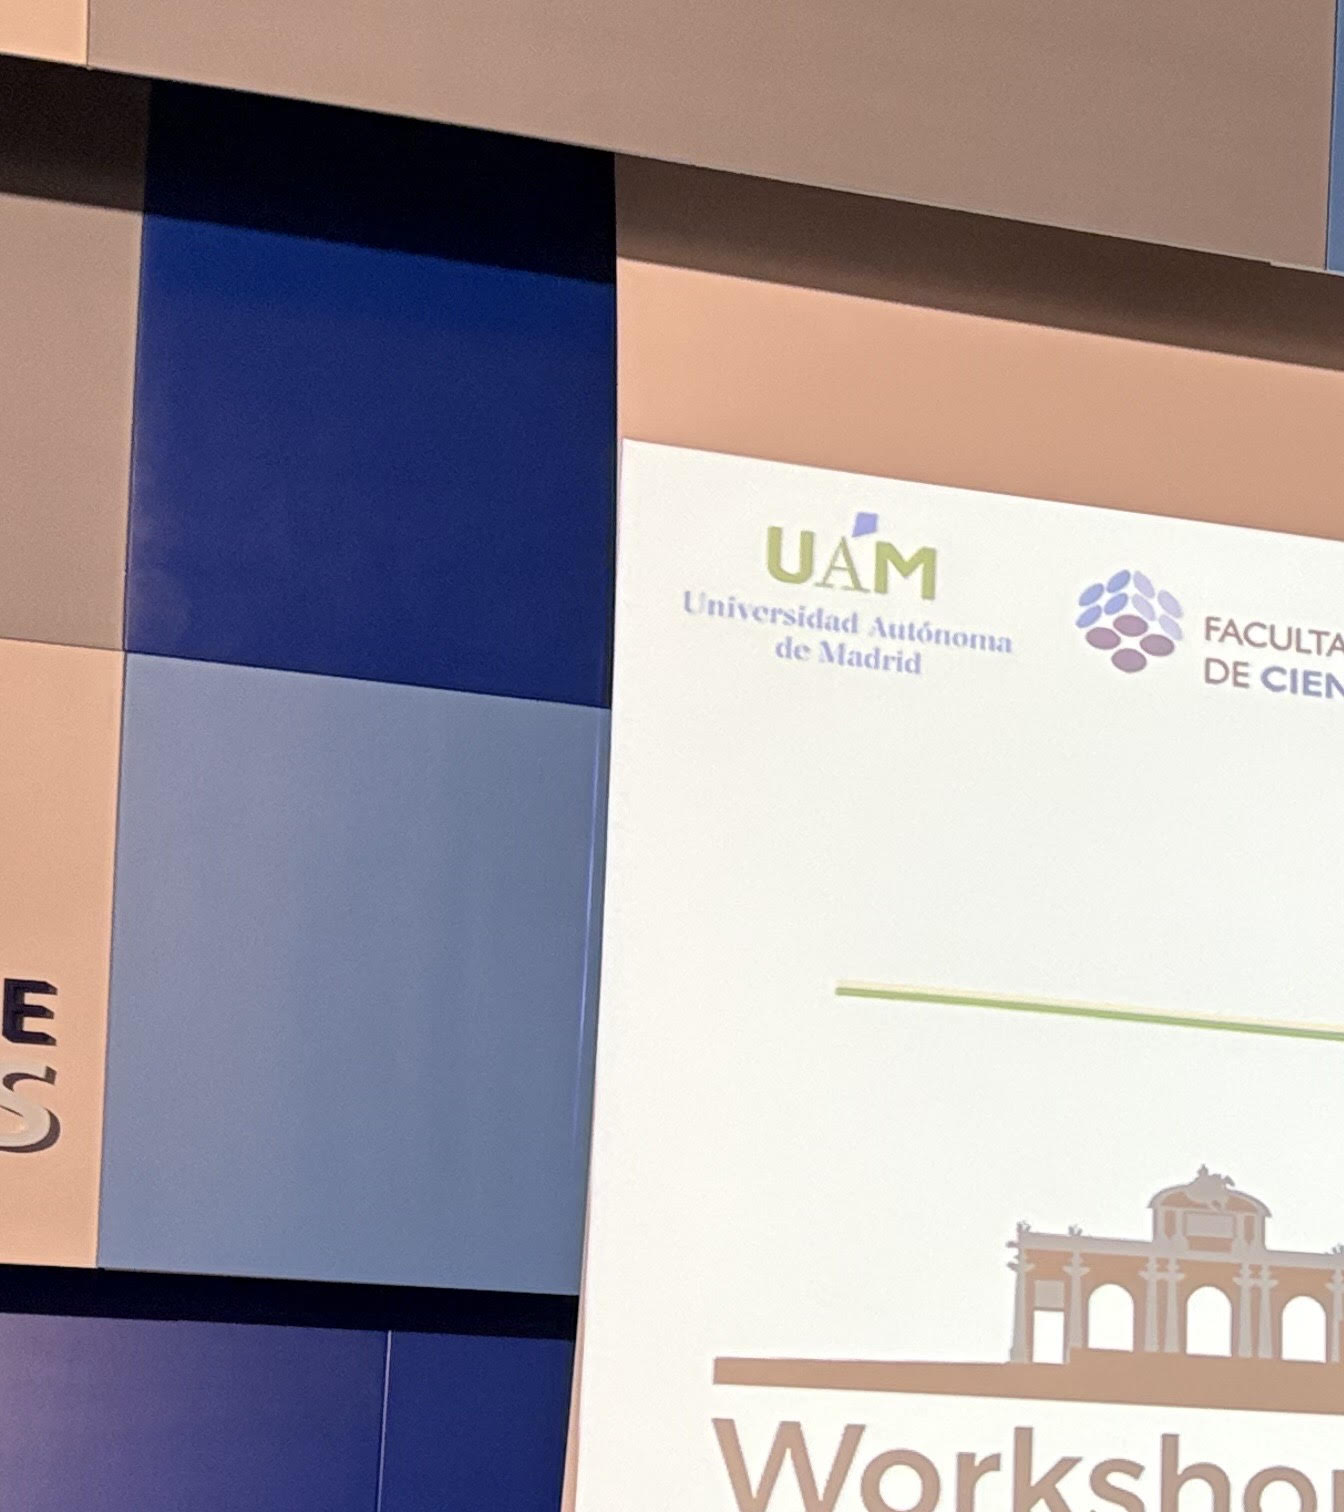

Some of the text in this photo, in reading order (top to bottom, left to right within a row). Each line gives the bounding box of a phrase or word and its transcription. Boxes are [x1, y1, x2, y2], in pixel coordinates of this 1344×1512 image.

[683, 590, 1013, 655] Universidad Autónoma
[774, 636, 922, 675] de Madrid
[1203, 657, 1252, 690] DE
